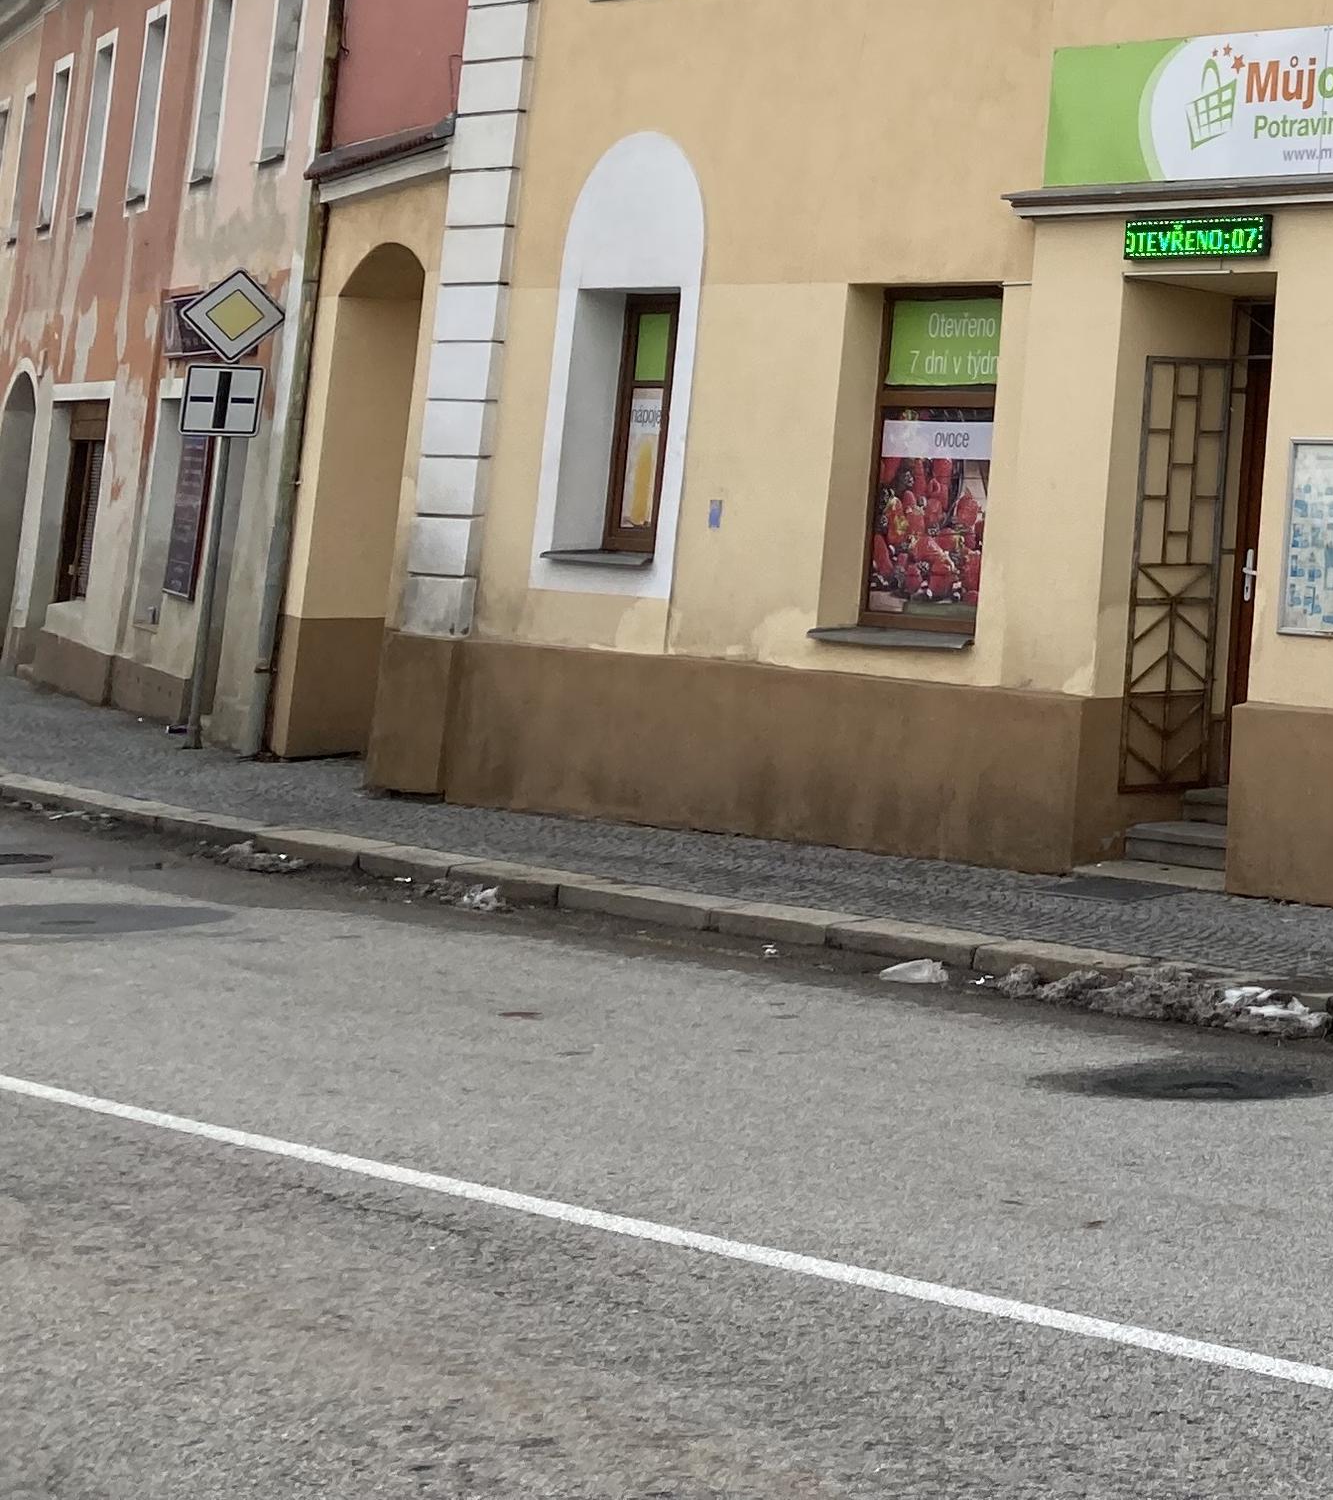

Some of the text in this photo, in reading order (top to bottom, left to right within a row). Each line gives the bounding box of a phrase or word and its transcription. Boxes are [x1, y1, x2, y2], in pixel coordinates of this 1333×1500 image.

[928, 312, 996, 339] Otevřeno
[909, 350, 921, 374] 7
[925, 349, 949, 375] dní
[952, 357, 962, 376] v
[934, 431, 970, 448] ovoce
